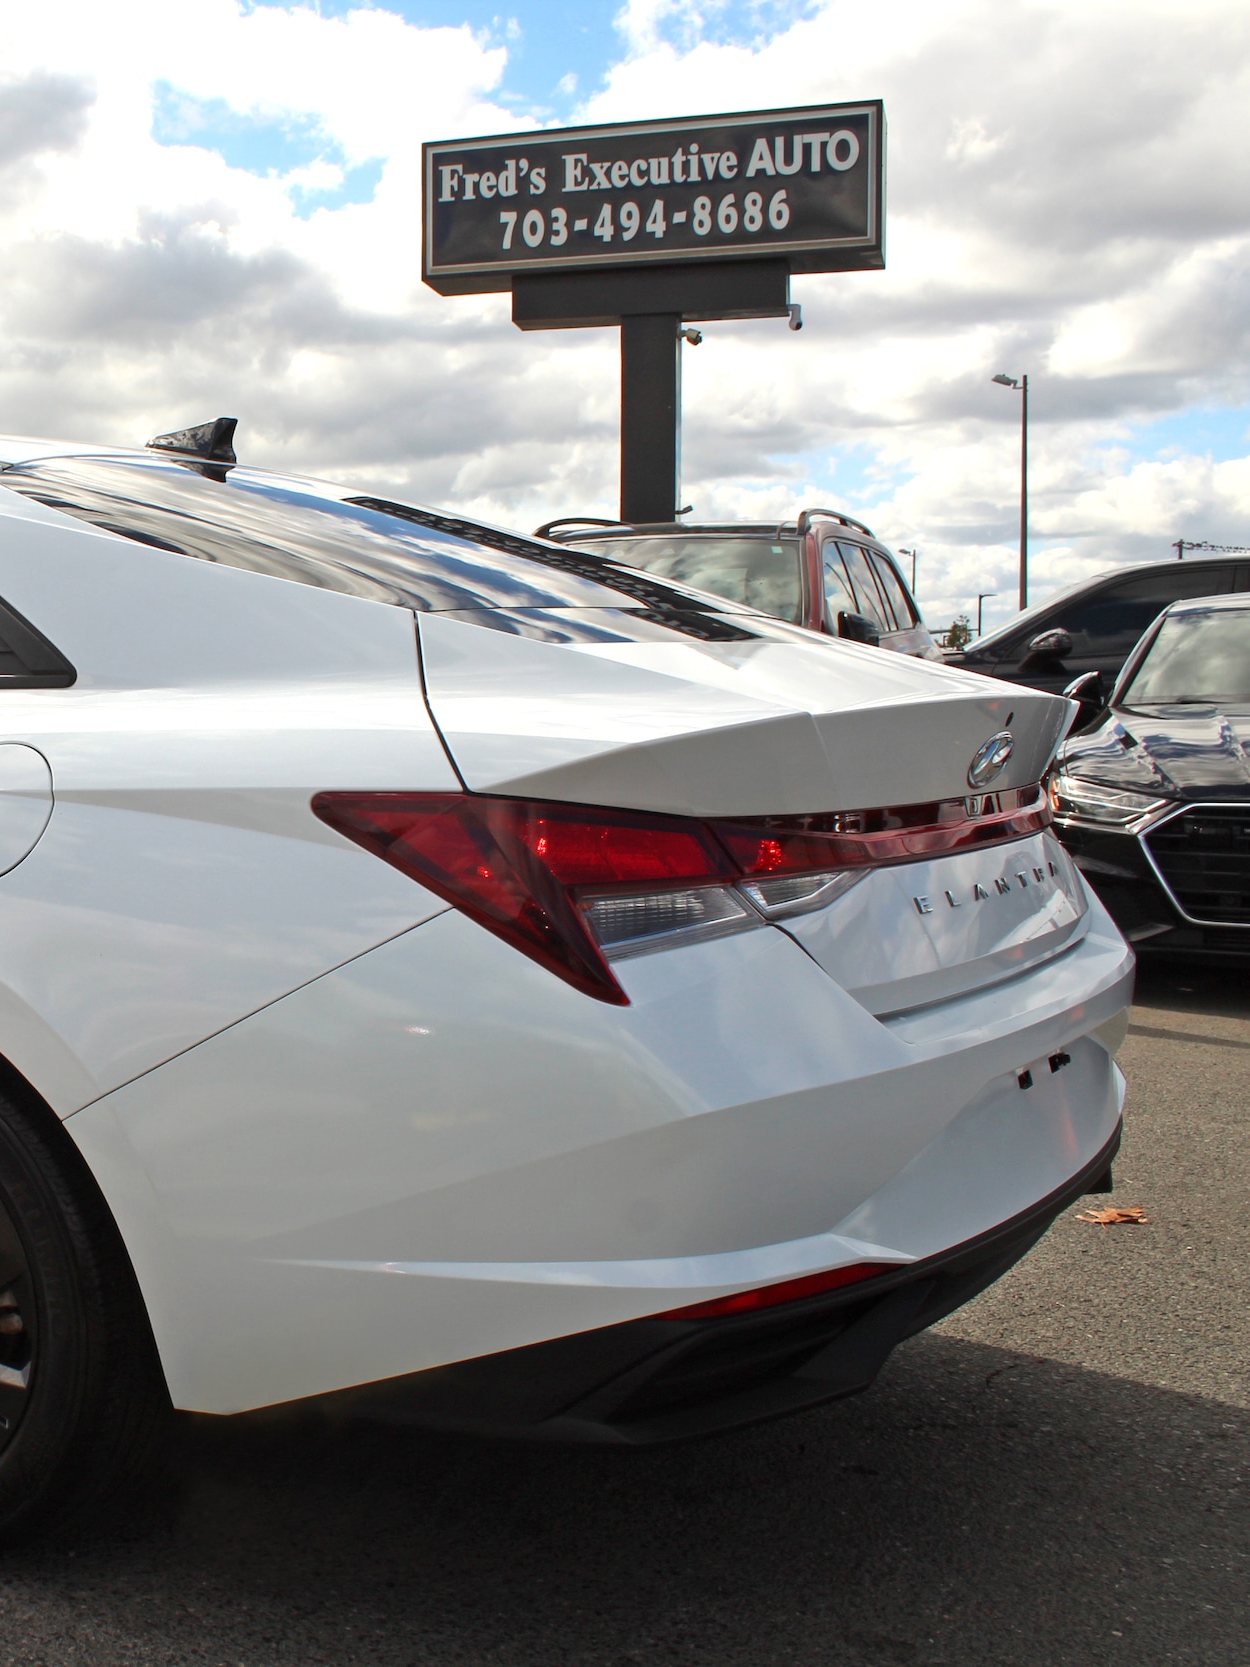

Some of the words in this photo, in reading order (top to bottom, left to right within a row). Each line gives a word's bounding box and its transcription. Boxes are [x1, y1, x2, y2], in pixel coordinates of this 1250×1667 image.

[438, 158, 547, 202] Fred's
[562, 143, 739, 193] Executive
[746, 130, 860, 178] AUTO
[499, 189, 790, 250] 703-494-8686
[913, 861, 1060, 915] ELANTRA
